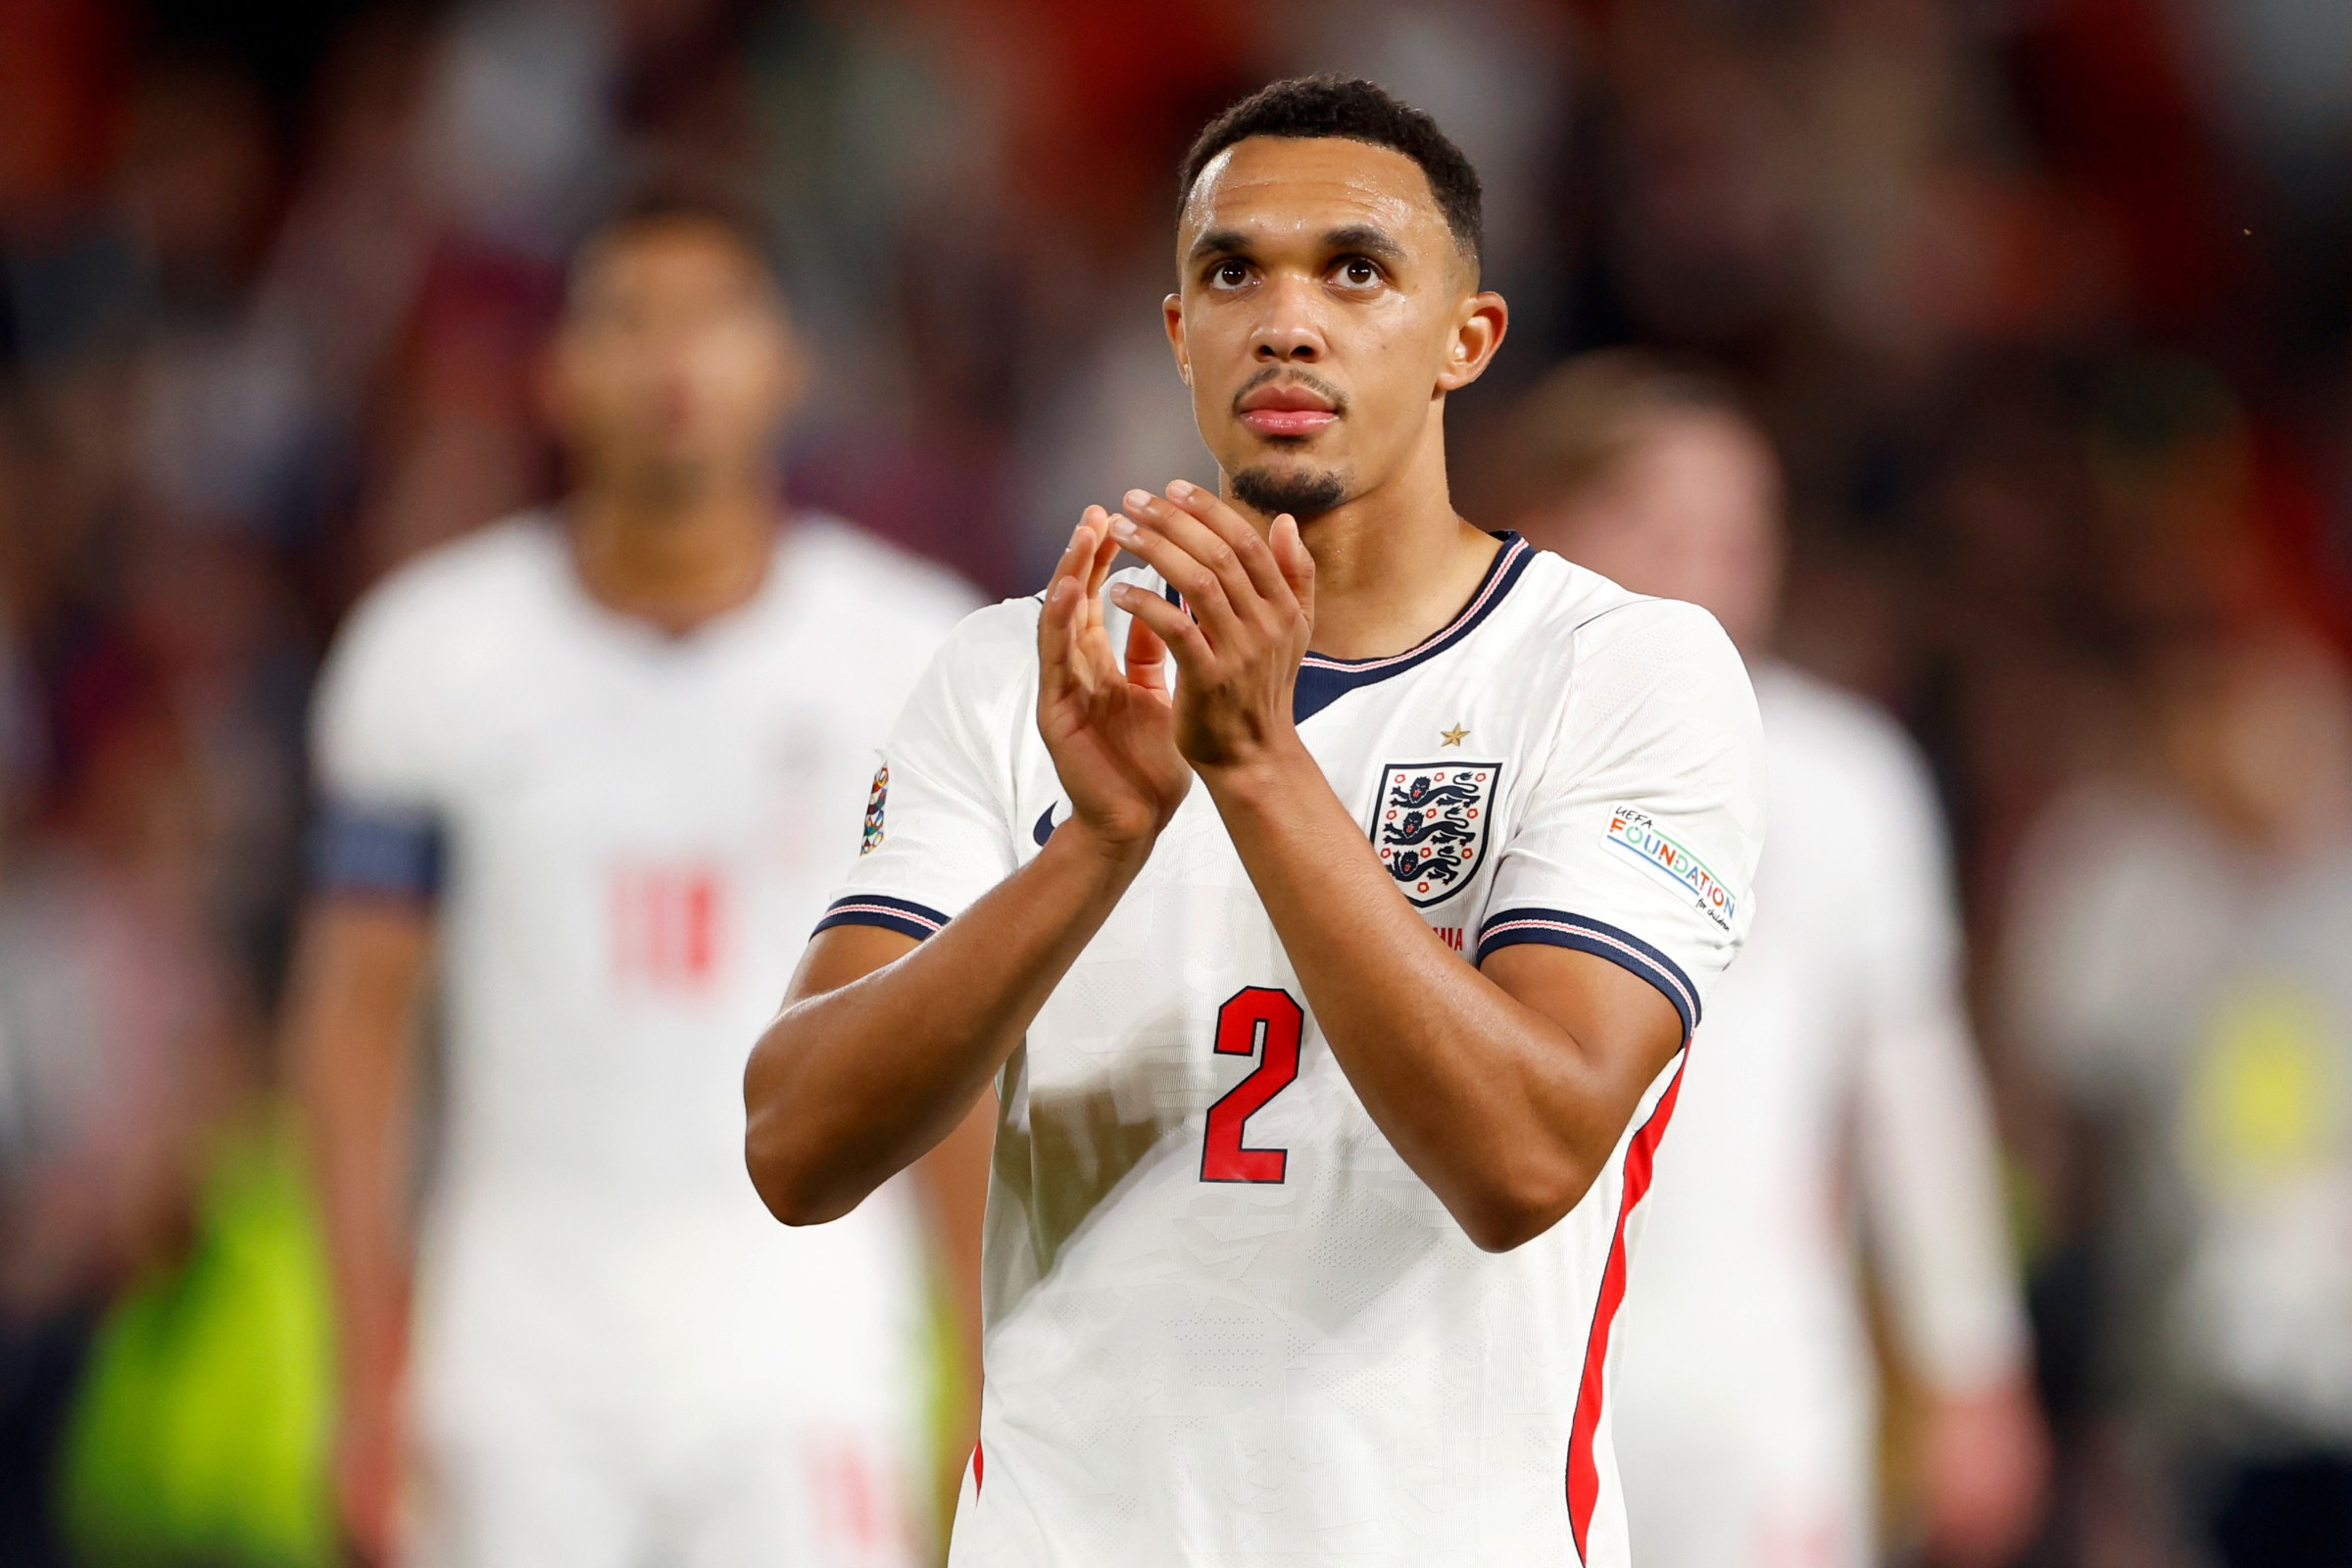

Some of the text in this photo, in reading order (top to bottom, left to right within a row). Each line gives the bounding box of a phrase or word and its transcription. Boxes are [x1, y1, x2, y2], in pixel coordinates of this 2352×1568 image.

[1615, 806, 1653, 829] UEFA
[1609, 817, 1736, 919] FOUNDATION
[1695, 898, 1730, 933] for children
[1200, 985, 1304, 1184] 2
